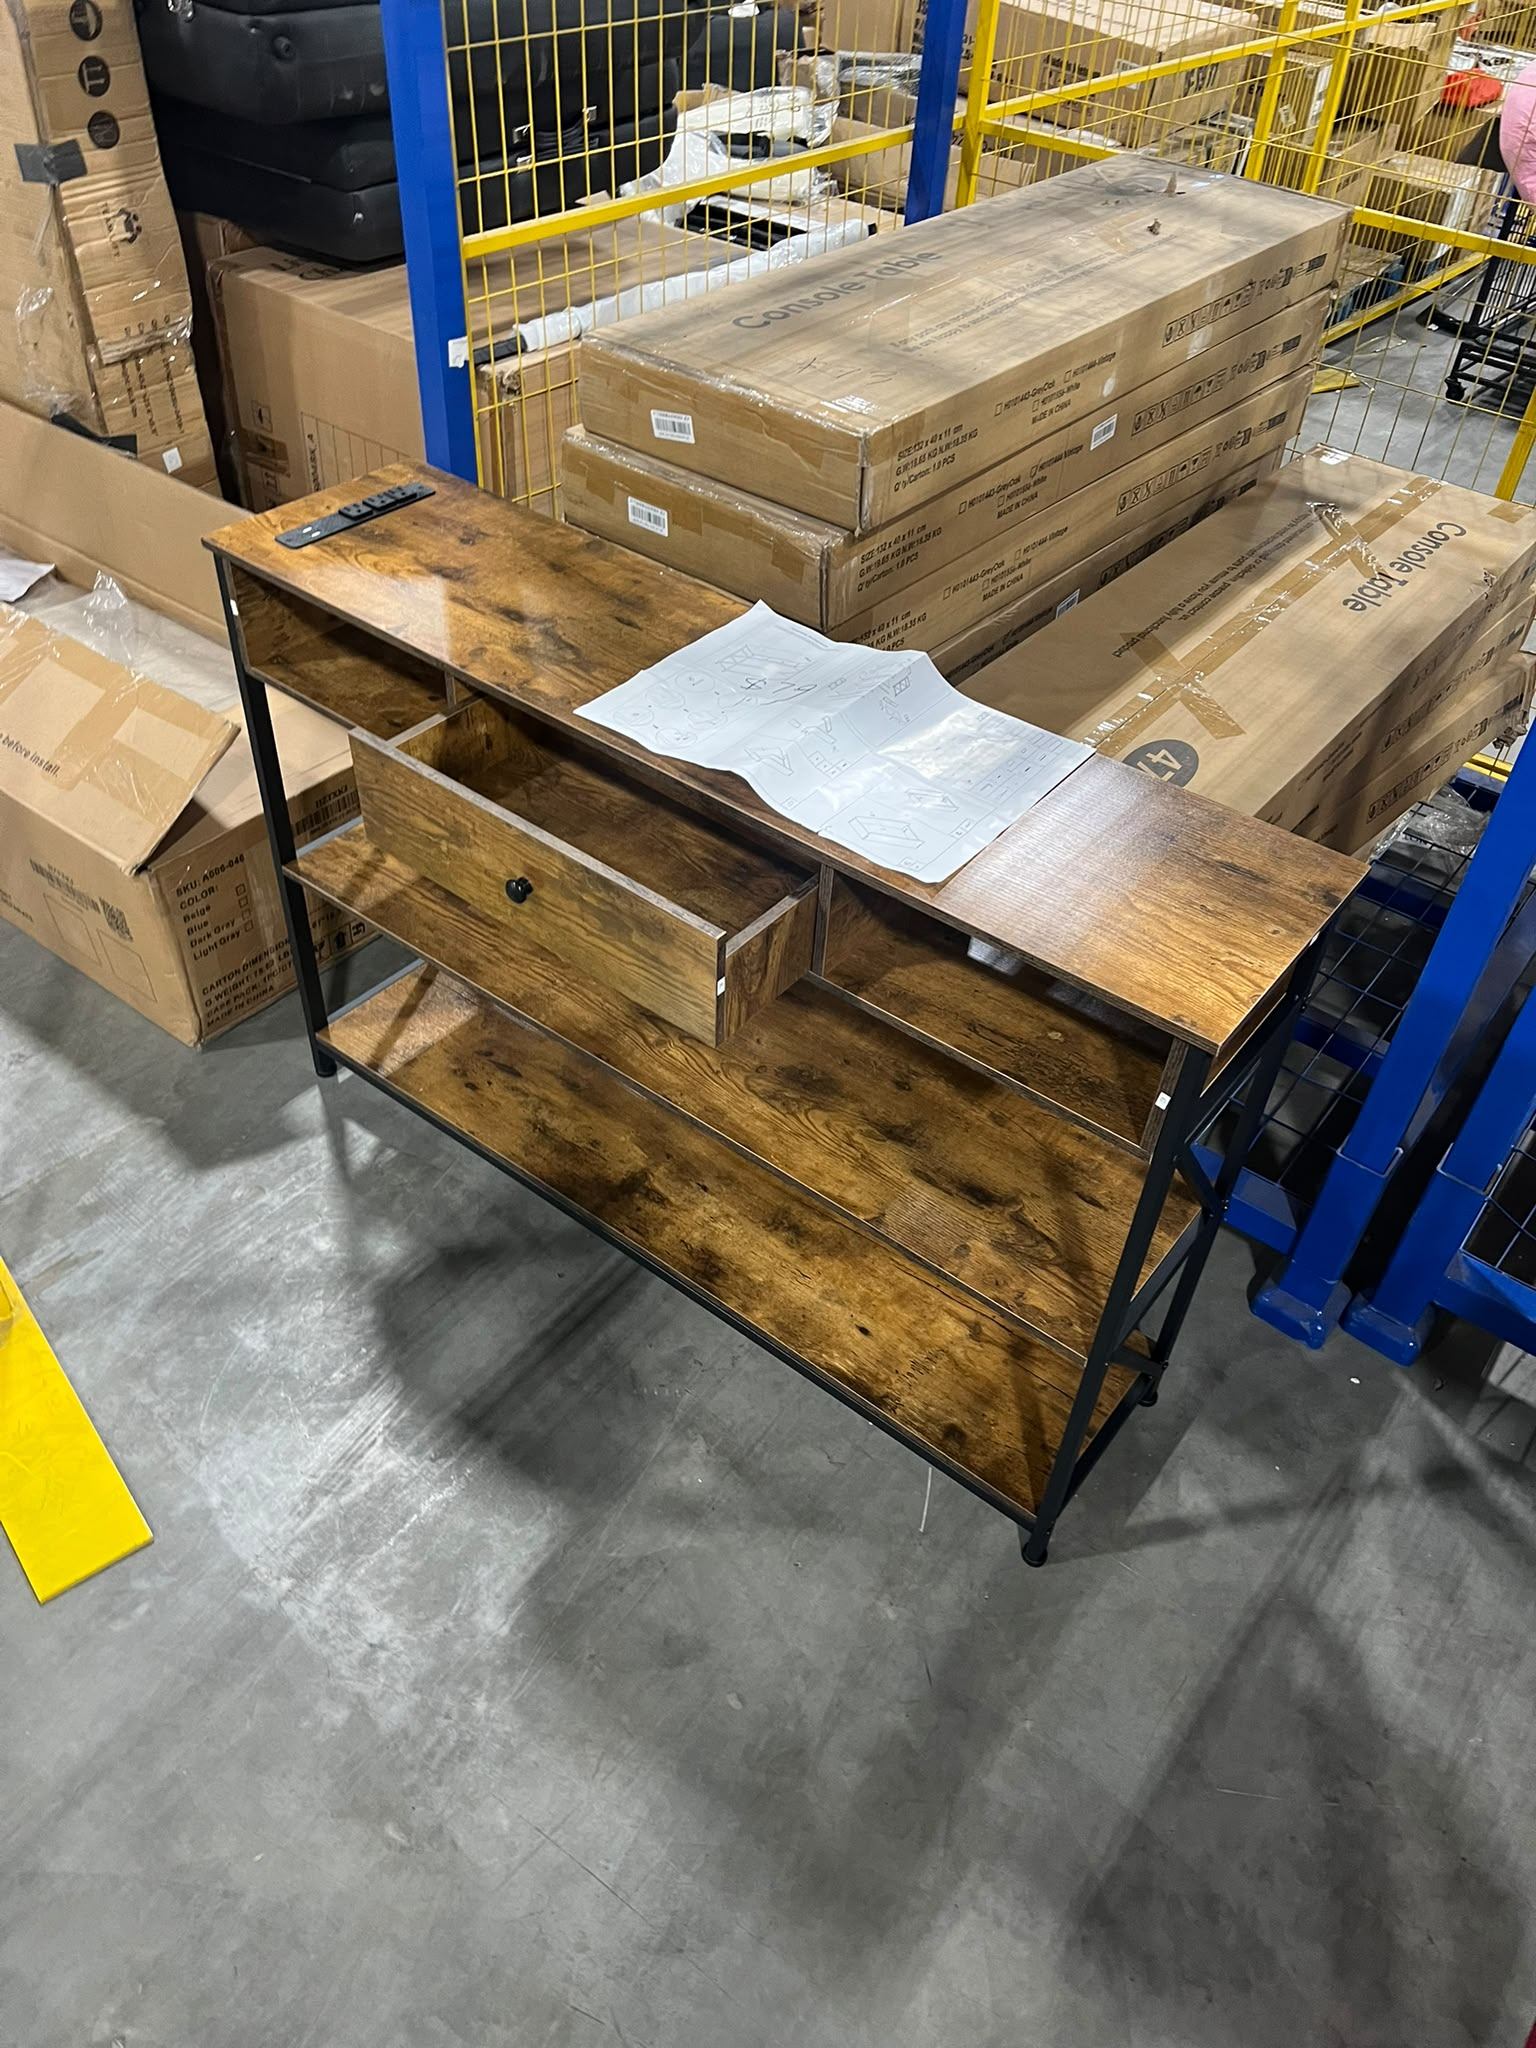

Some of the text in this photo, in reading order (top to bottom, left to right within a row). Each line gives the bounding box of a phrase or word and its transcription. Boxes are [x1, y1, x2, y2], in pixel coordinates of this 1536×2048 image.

[732, 280, 867, 329] Console
[854, 252, 943, 281] Table
[942, 453, 956, 467] PCS
[996, 491, 1039, 519] MADE IN CHINA
[905, 551, 919, 565] PCS
[1341, 521, 1468, 612] Console Table
[982, 573, 1024, 602] MADE IN CHINA
[900, 610, 911, 621] cm
[916, 612, 927, 624] KG
[2, 735, 30, 758] before
[176, 880, 201, 898] SKU:
[179, 884, 219, 910] COLOR:
[183, 904, 212, 924] Beige
[186, 920, 209, 937] Blue
[190, 918, 236, 949] Dark Gray
[193, 929, 241, 962] Light Gray
[202, 967, 242, 996] CARTON
[207, 984, 275, 1028] MADE IN CHINA
